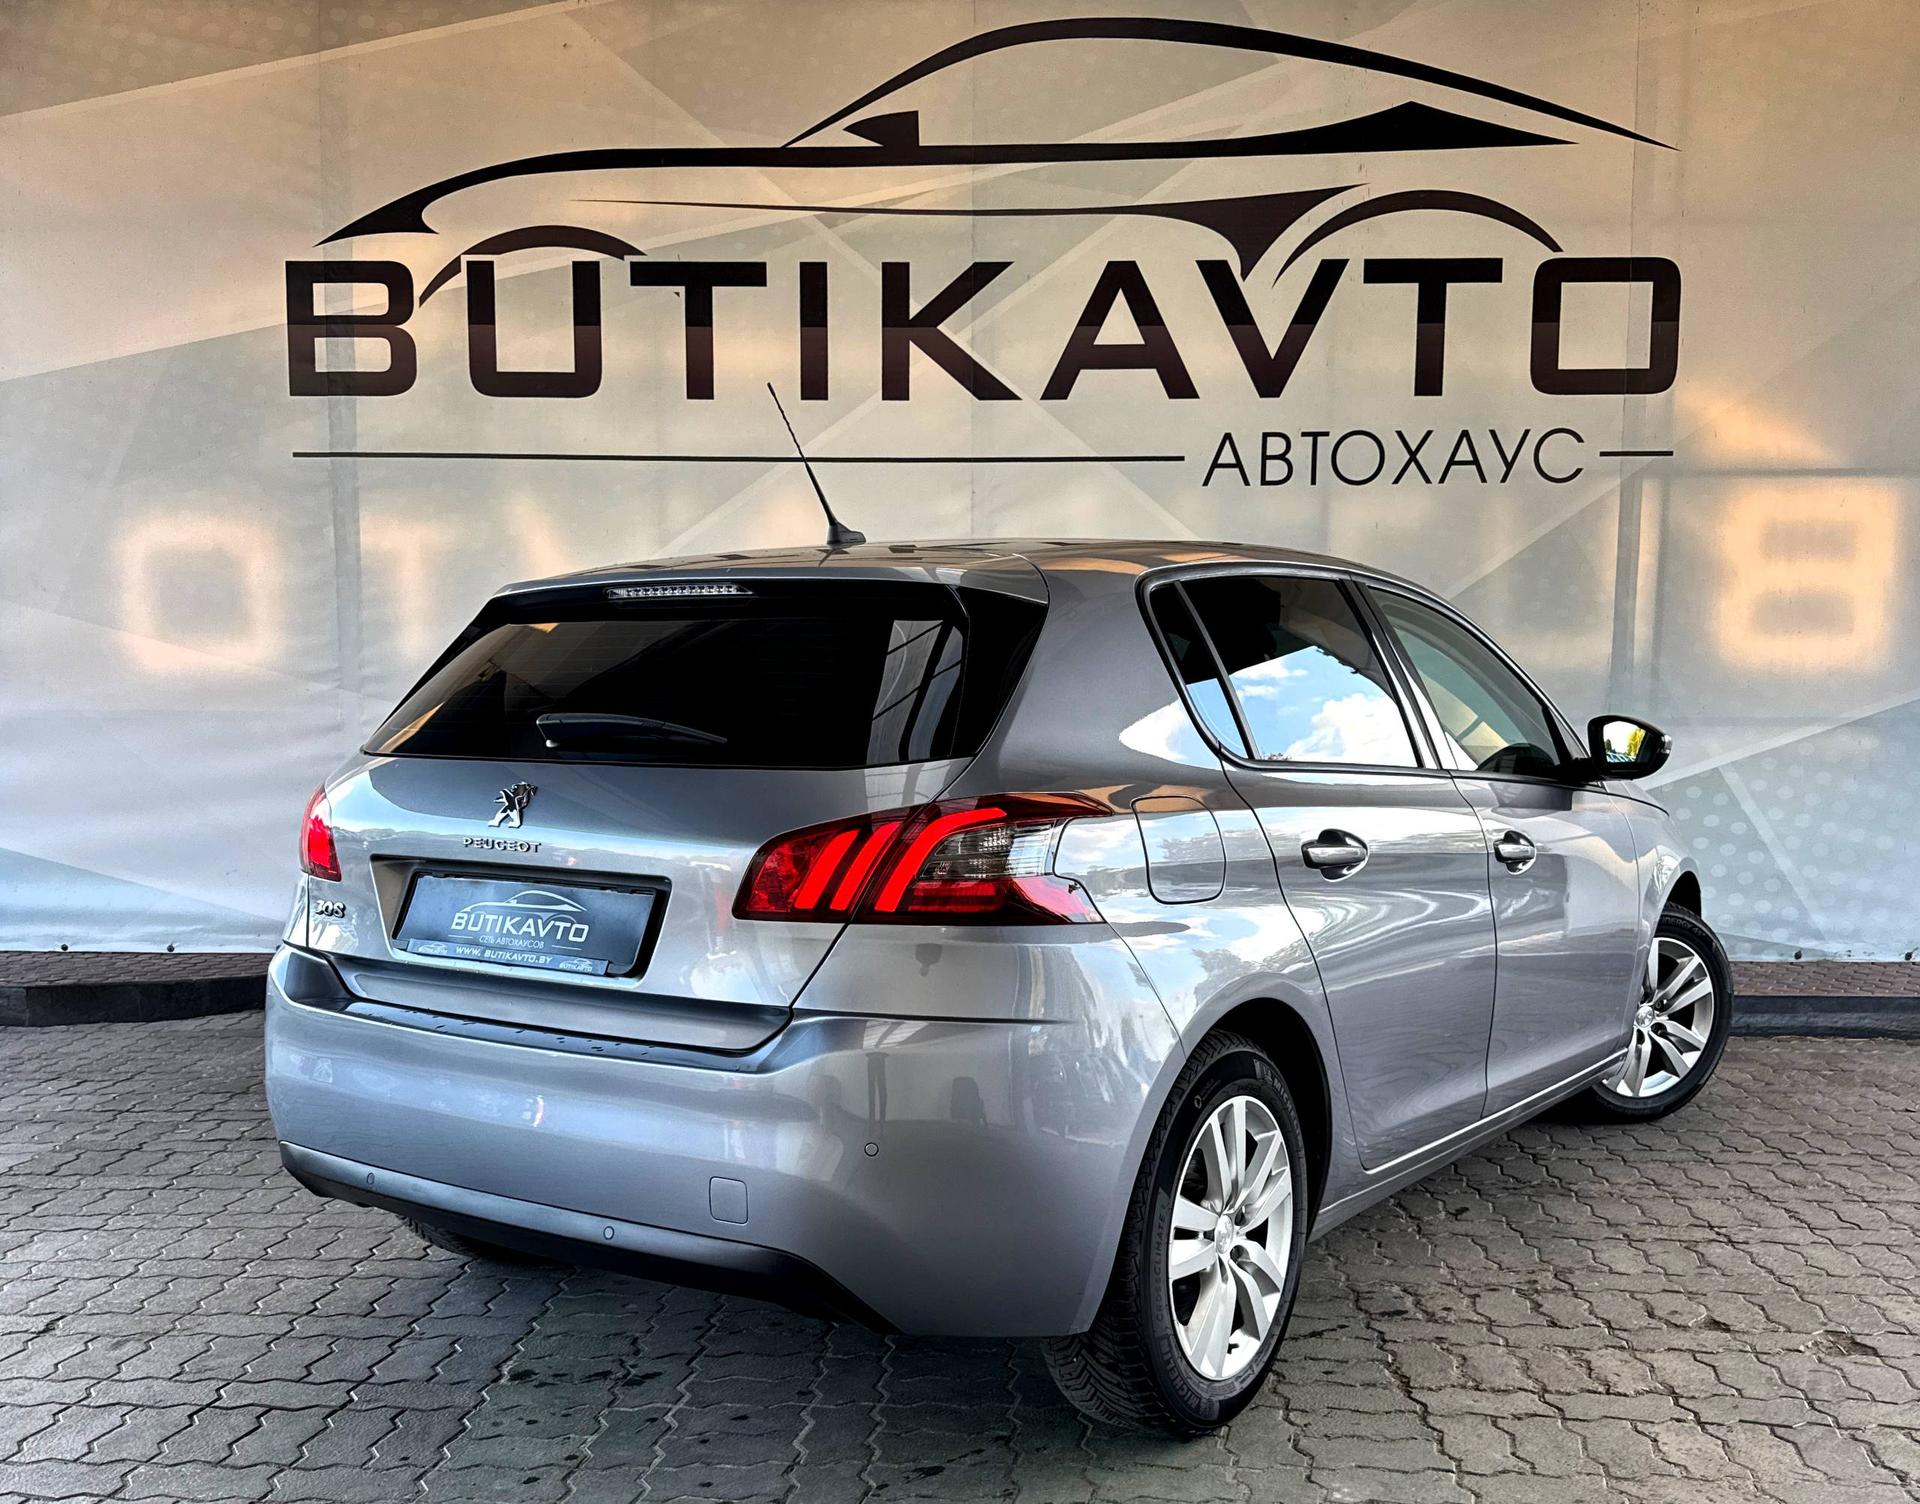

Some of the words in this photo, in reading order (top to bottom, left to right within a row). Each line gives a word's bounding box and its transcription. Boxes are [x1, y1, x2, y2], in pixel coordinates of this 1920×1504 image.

[285, 257, 1682, 400] BUTIKAVTO
[1202, 428, 1585, 487] АВТОХАУС
[463, 836, 542, 853] PEUGEOT
[451, 912, 590, 943] BUTIKAVTO
[484, 949, 553, 964] BUTIKAVTO.BY
